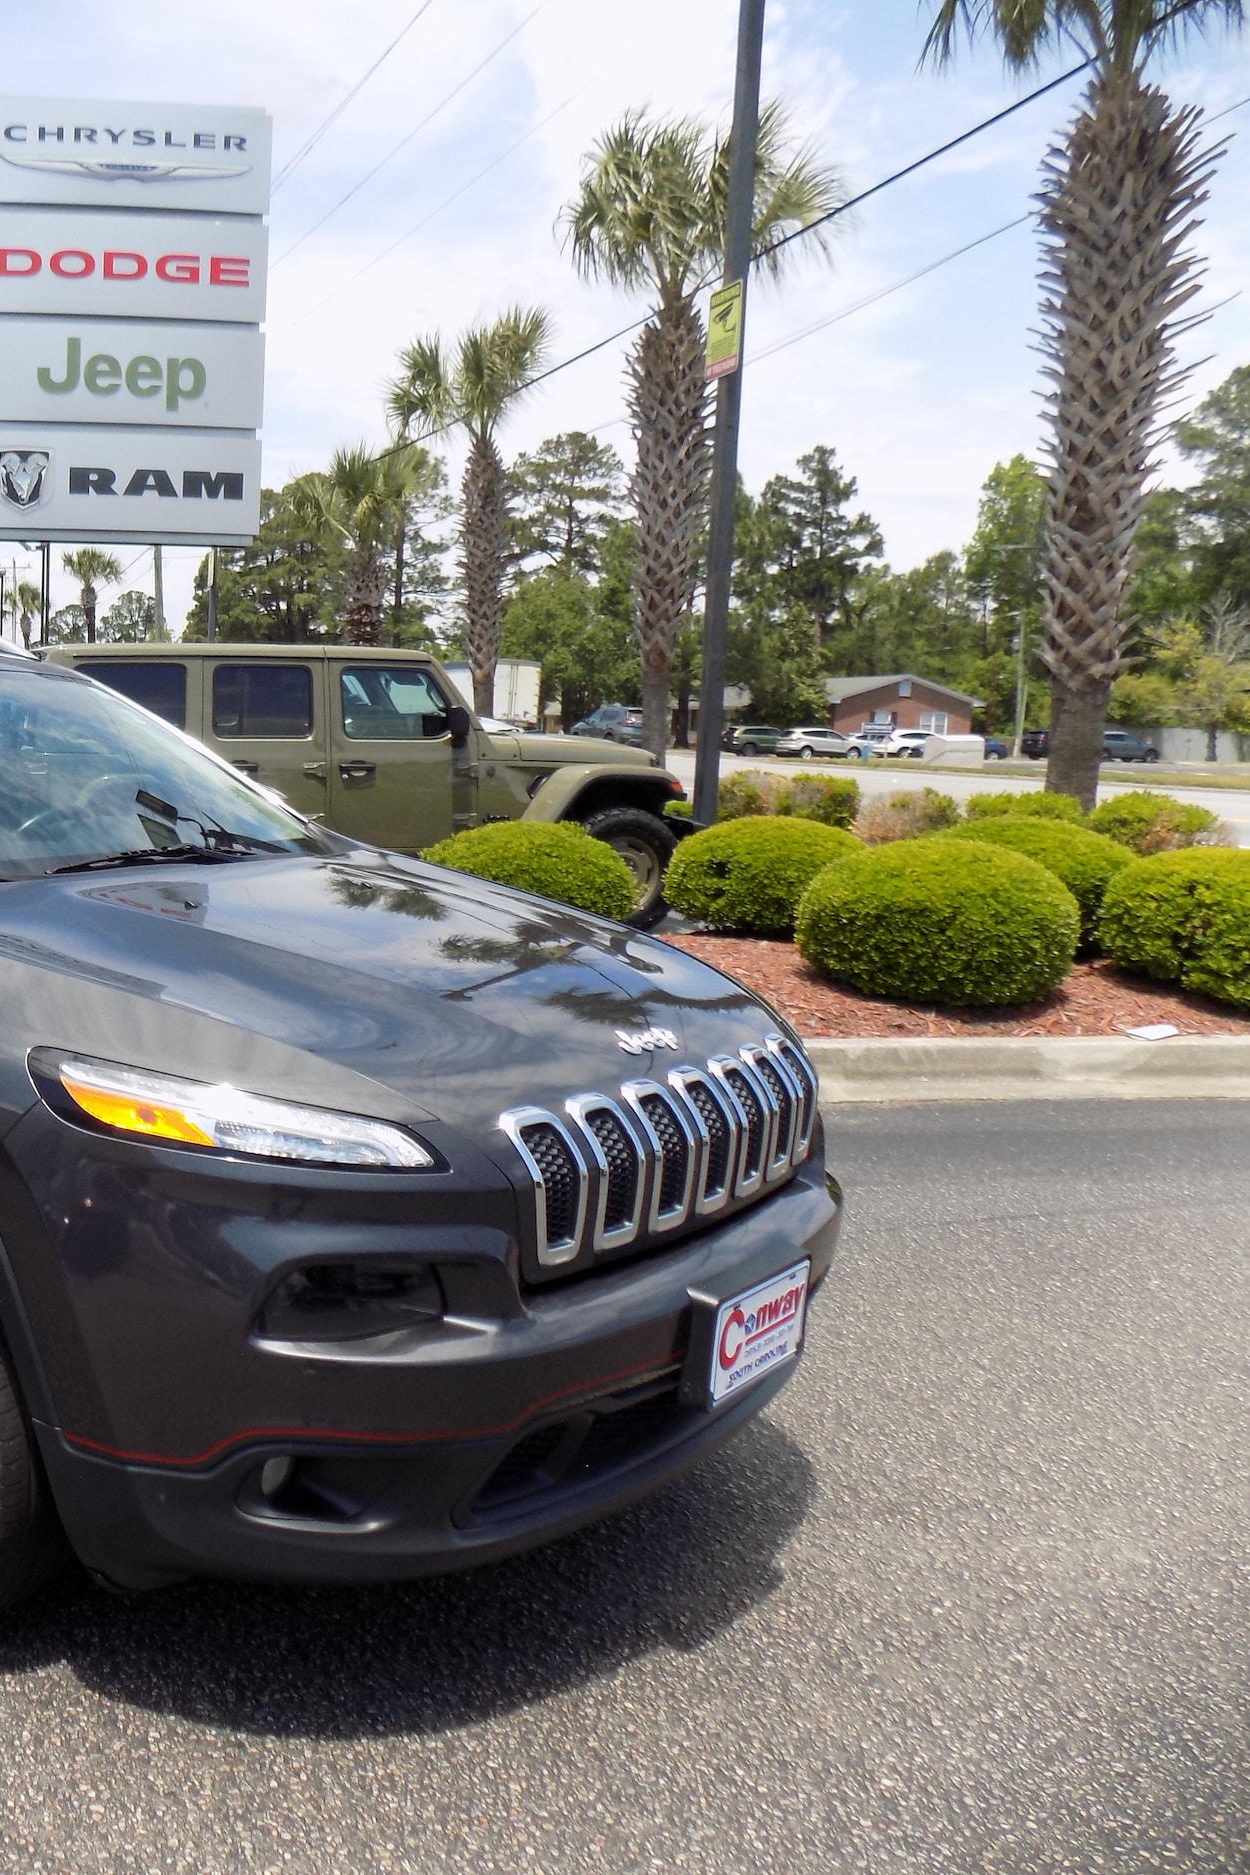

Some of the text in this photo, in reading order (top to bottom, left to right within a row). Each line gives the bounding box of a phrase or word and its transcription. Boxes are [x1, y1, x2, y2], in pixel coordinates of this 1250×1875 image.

[3, 125, 248, 152] CHRYSLER
[37, 337, 207, 411] Jeep
[68, 467, 244, 500] RAM
[614, 1027, 678, 1055] Jeep
[719, 1282, 805, 1370] Conway
